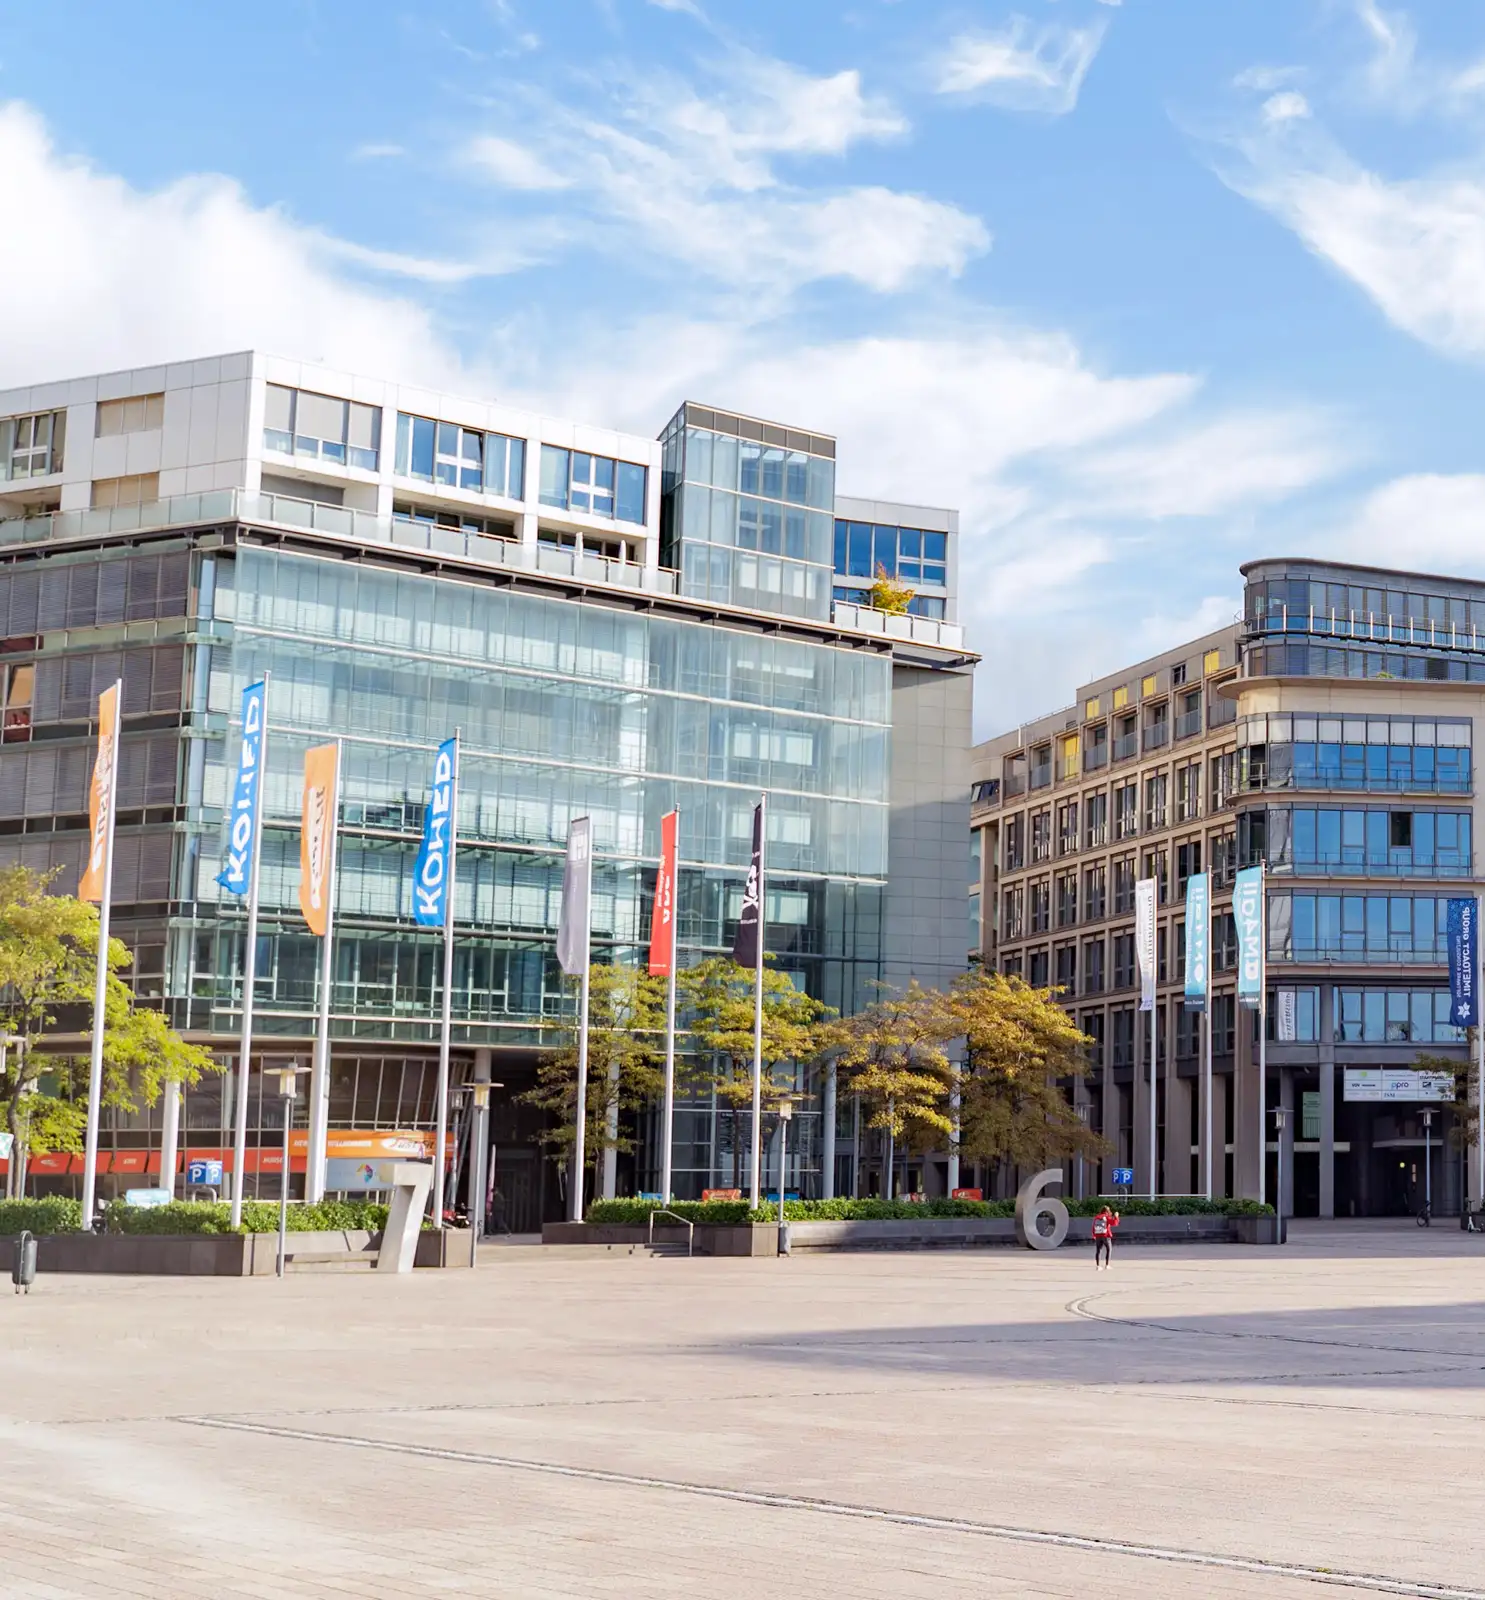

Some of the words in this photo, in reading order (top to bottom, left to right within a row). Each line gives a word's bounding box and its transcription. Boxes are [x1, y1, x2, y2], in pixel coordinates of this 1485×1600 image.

[192, 1167, 202, 1182] P
[1015, 1168, 1069, 1251] 6
[377, 1162, 434, 1274] 7
